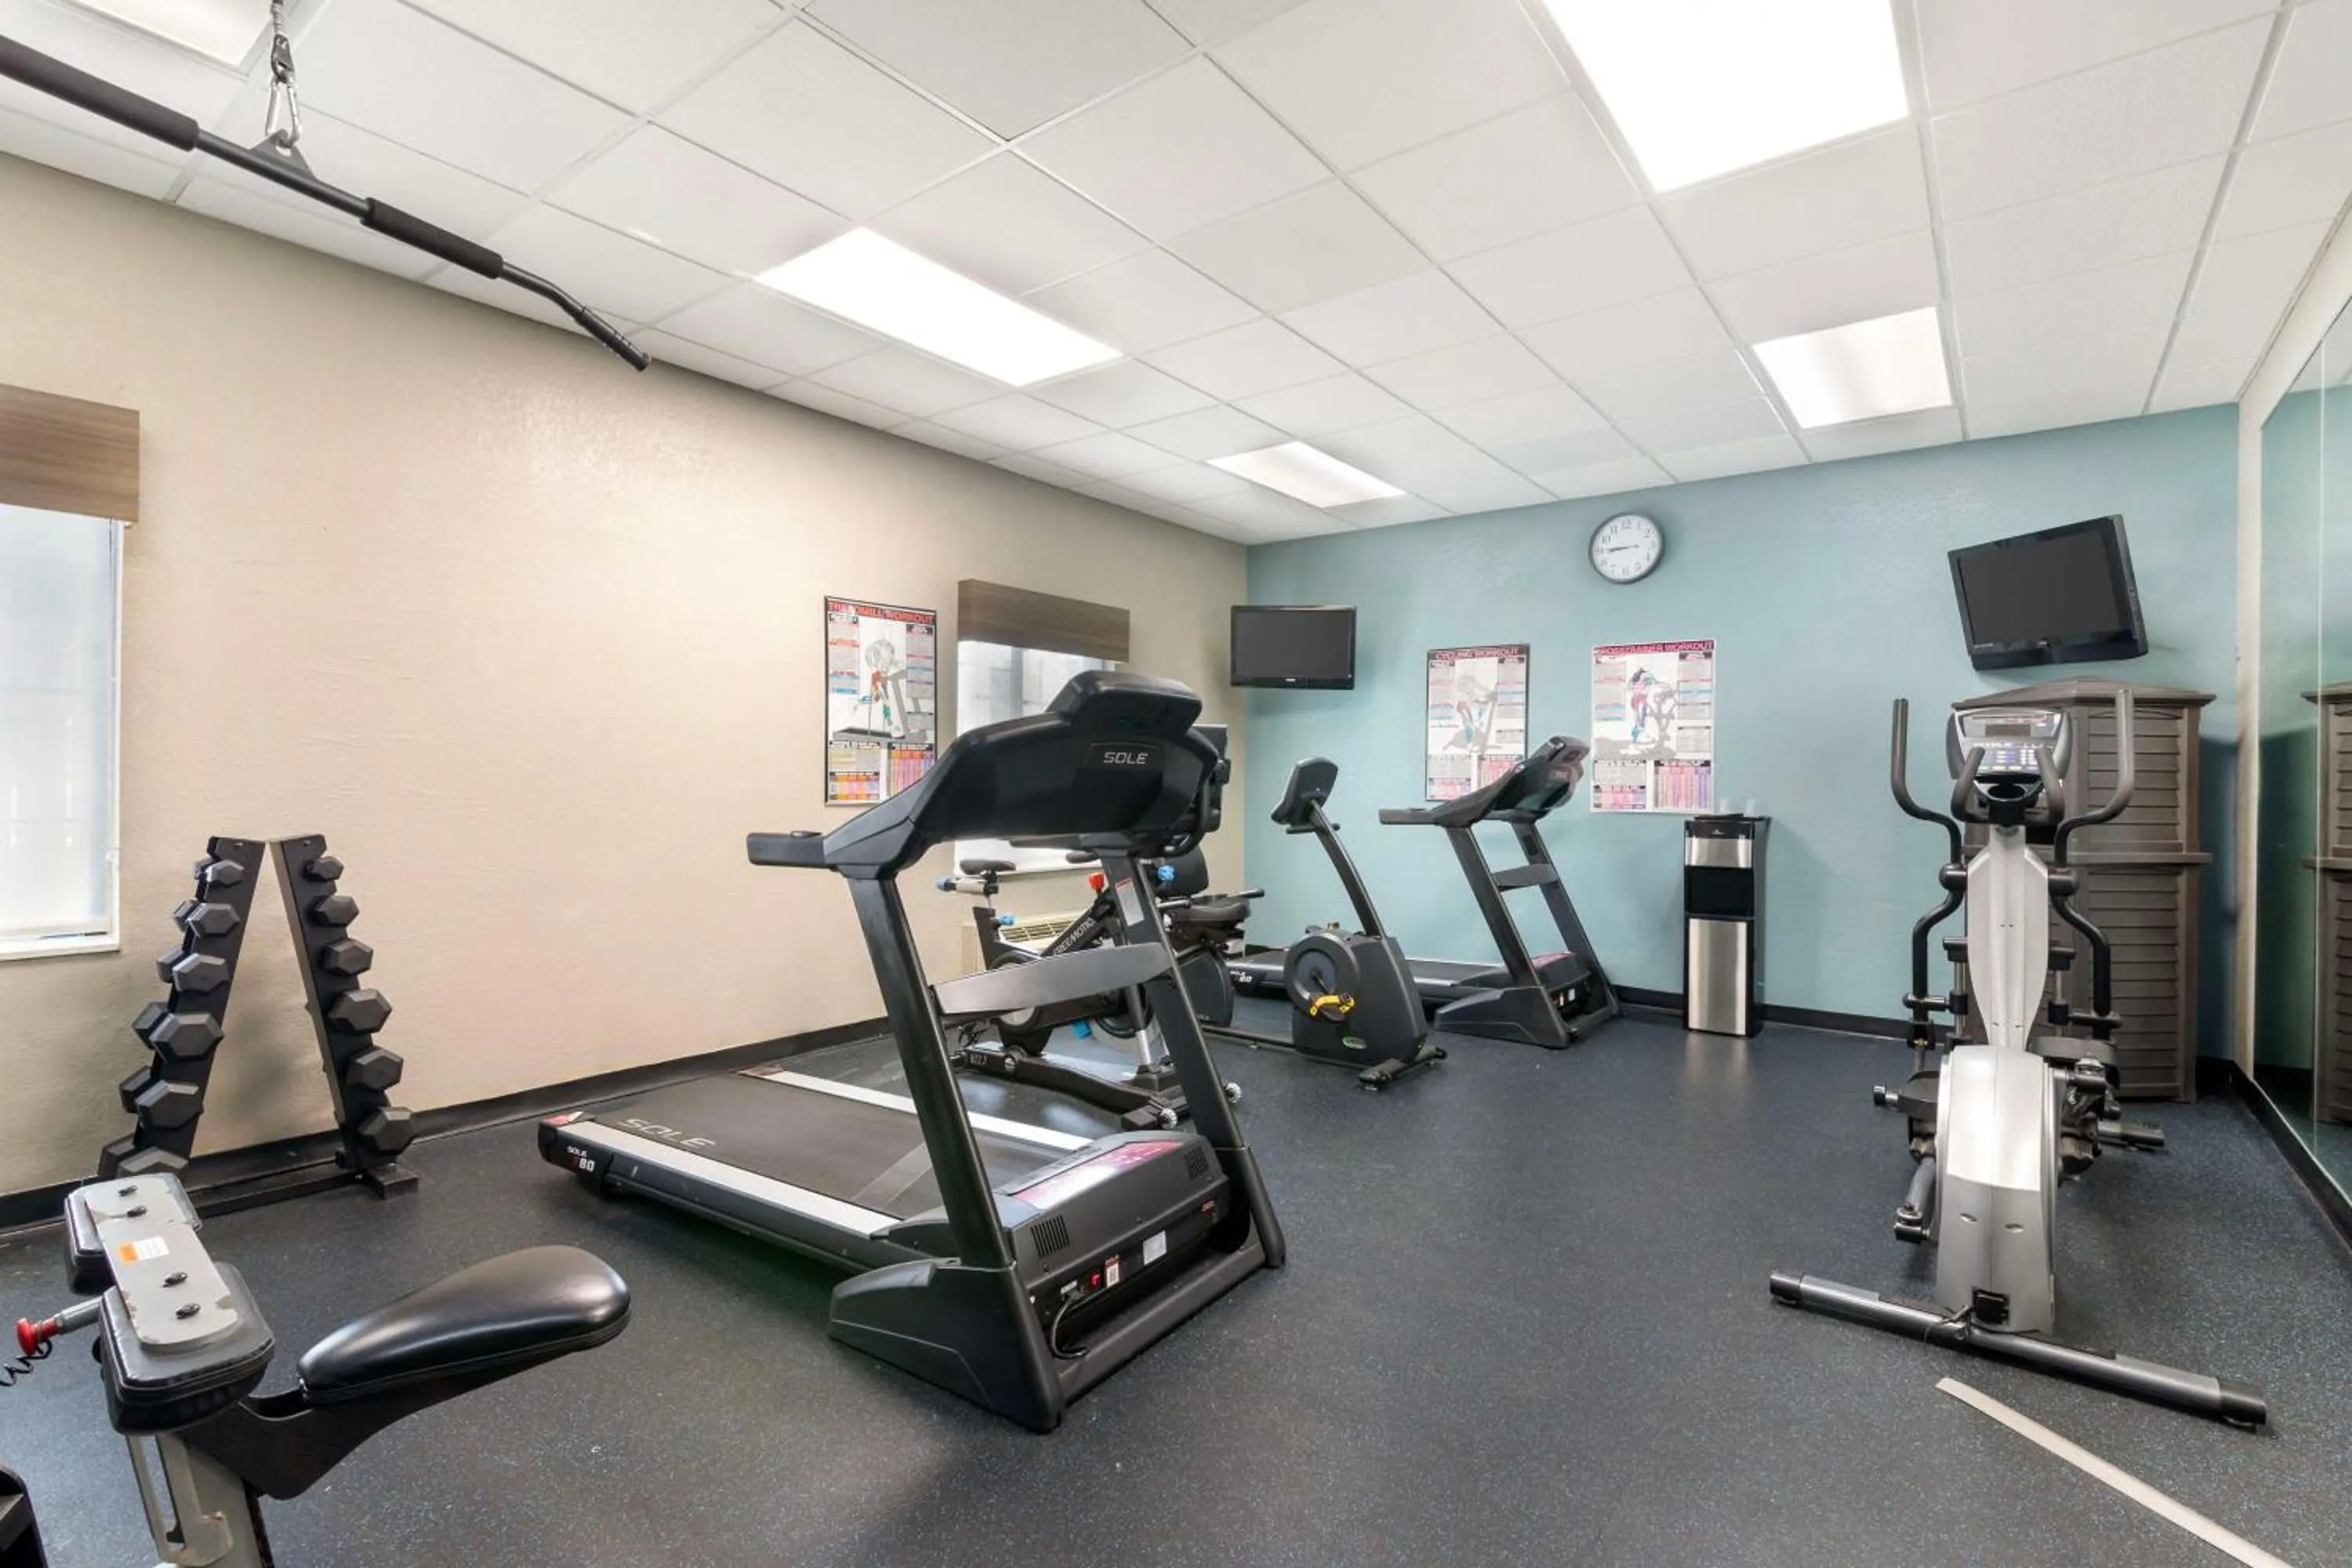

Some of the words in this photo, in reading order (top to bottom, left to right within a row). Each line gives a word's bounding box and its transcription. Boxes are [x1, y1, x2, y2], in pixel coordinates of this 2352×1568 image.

[1665, 641, 1712, 651] WORKOUT
[1104, 752, 1149, 764] SOLE
[1053, 916, 1096, 956] FREEMOTIO
[618, 1119, 715, 1149] SOLE
[567, 1145, 587, 1157] SOLE
